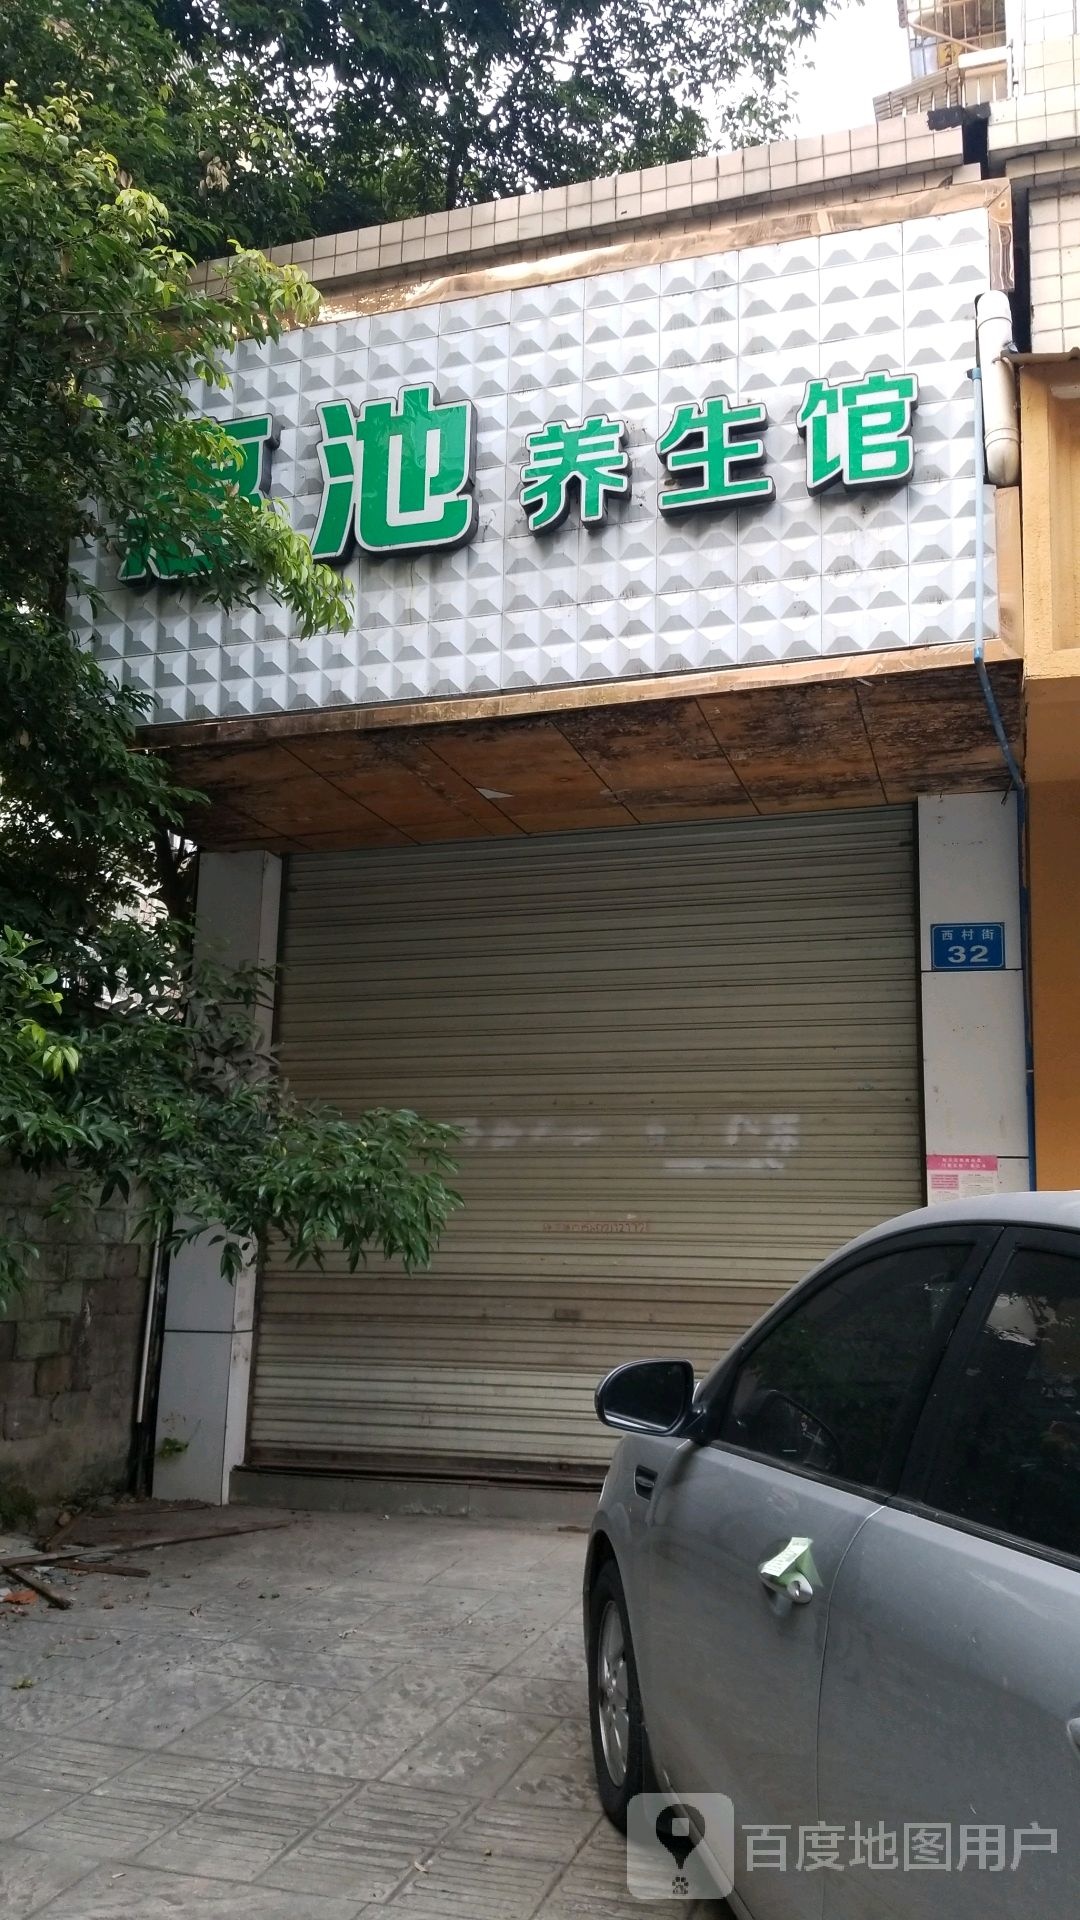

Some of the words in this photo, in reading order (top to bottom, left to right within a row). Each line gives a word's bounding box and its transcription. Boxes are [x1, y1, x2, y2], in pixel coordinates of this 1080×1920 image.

[941, 928, 995, 941] 西村街
[947, 945, 989, 963] 32
